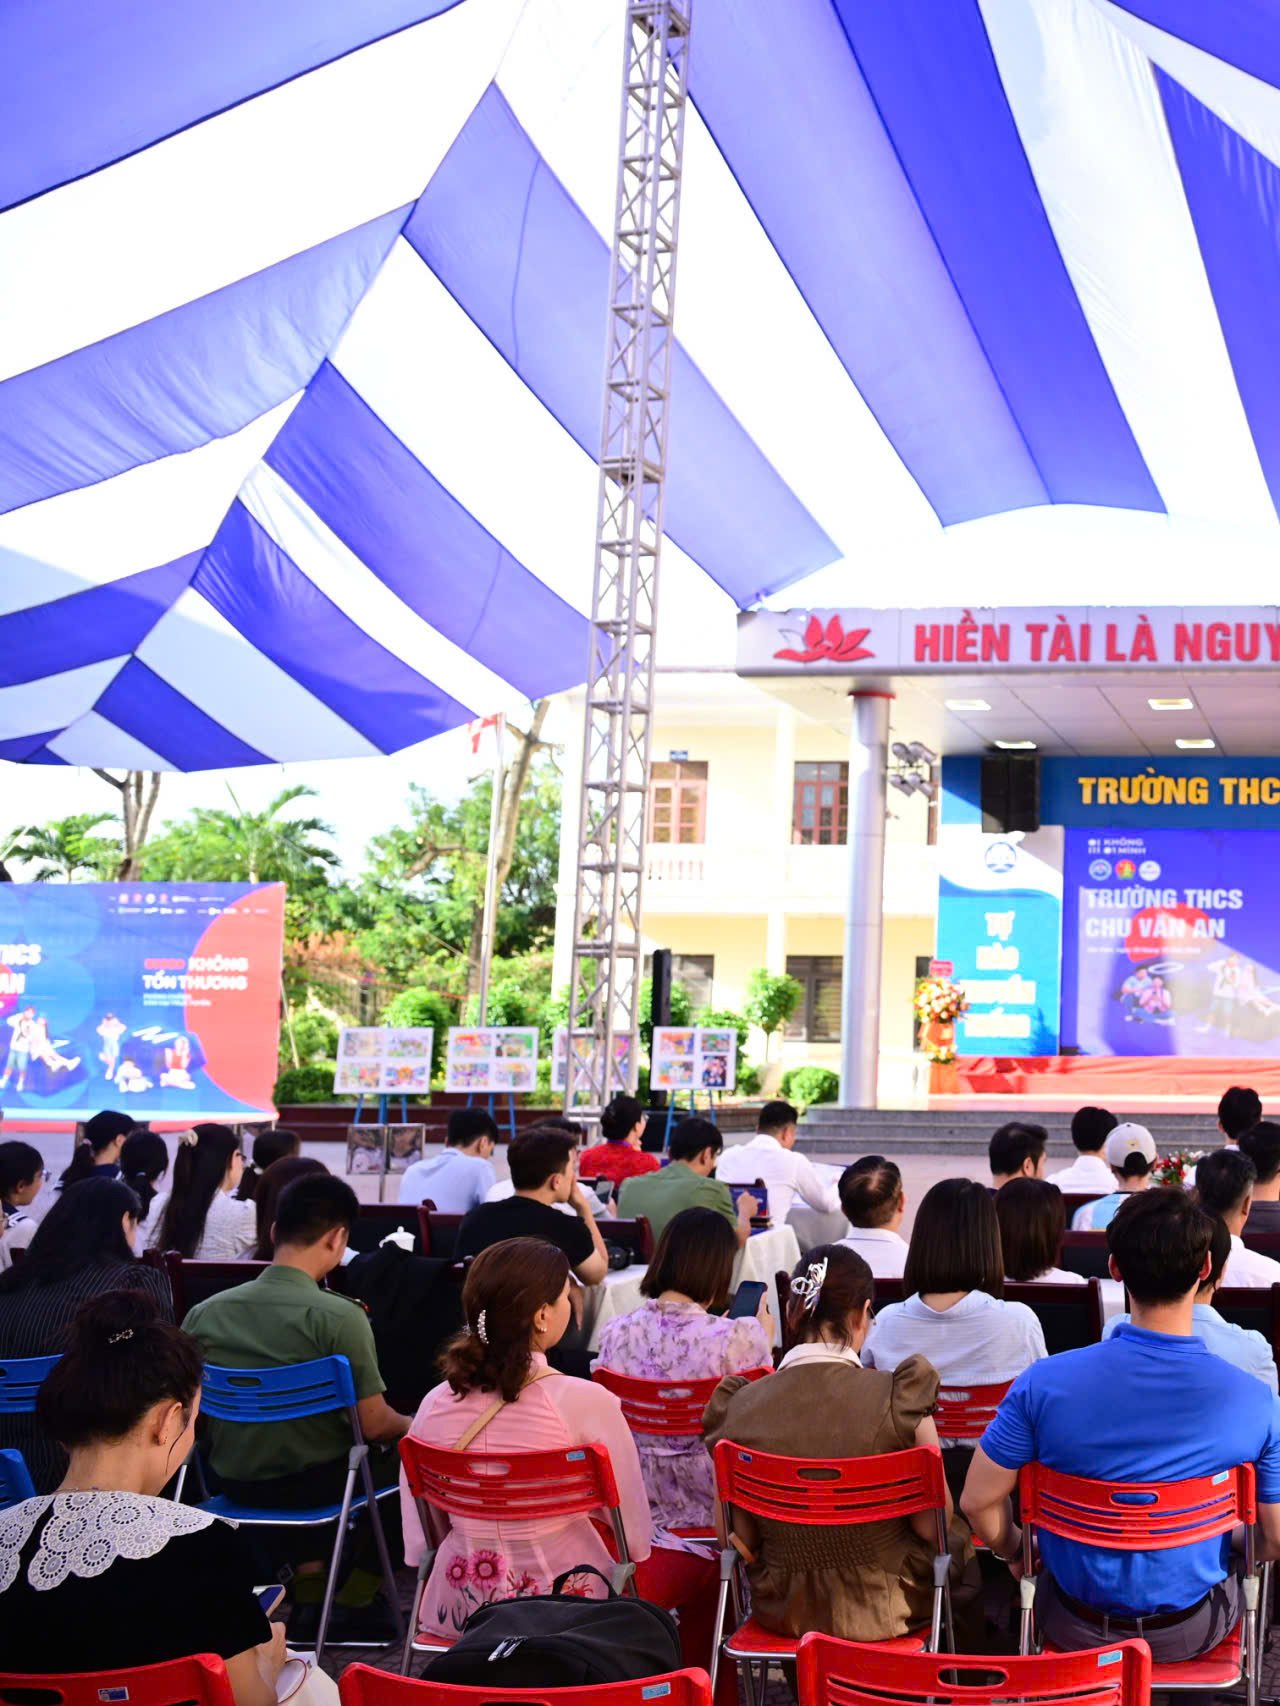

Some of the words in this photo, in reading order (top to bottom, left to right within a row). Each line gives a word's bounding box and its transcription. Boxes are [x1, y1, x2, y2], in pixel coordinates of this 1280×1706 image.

[914, 609, 1011, 663] HIỀN
[1025, 614, 1091, 663] TÀI
[1105, 614, 1157, 663] LÀ
[1078, 767, 1209, 805] TRƯỜNG
[1086, 884, 1178, 910] TRƯỜNG
[1184, 888, 1244, 909] THCS
[1085, 917, 1132, 938] CHU
[1192, 918, 1226, 939] AN
